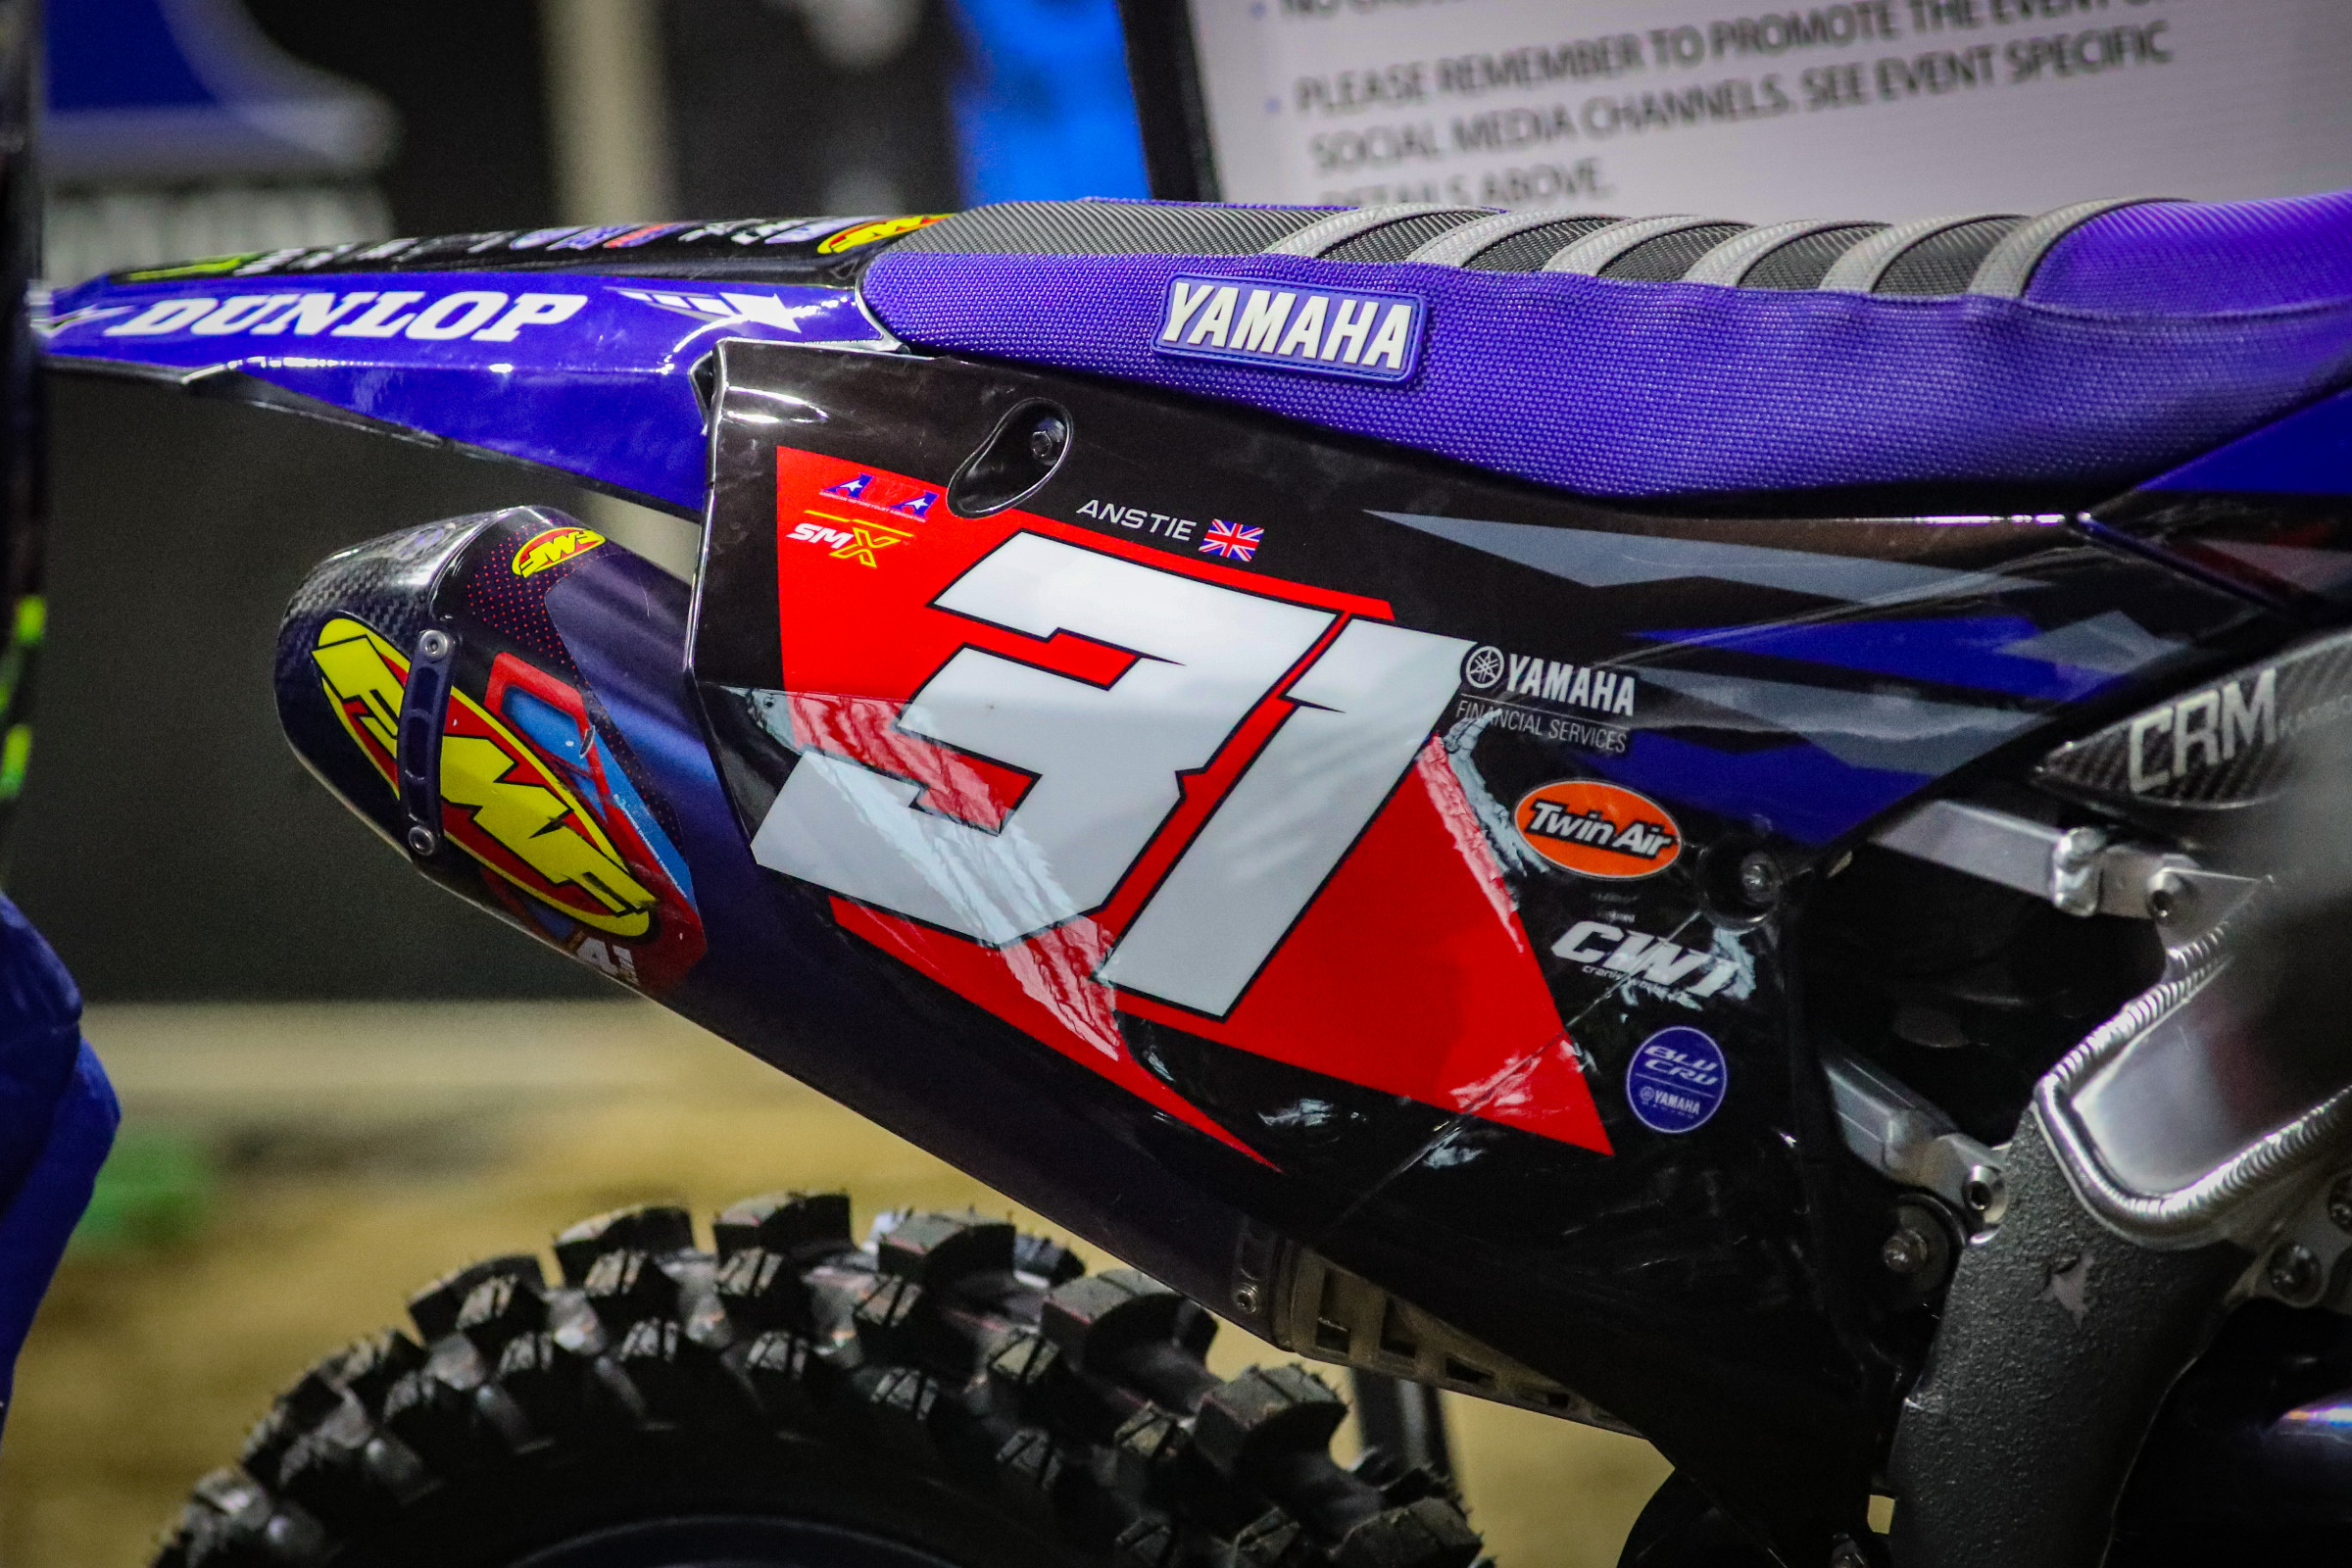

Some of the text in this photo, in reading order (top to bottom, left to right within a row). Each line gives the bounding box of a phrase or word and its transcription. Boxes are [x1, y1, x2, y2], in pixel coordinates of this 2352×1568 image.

[1295, 63, 1428, 113] PLEASE
[1436, 33, 1643, 93] REMEMBER
[1648, 24, 1705, 67] TO
[1709, 2, 1899, 59] PROMOTE
[1907, 0, 1984, 32] THE
[1309, 20, 2173, 174] SOCIAL MEDIA CHANNELS. SEE EVENT SPECIFIC
[1480, 157, 1615, 202] ABOVE.
[103, 291, 588, 343] DUNLOP
[1162, 281, 1413, 370] YAMAHA
[786, 522, 902, 568] SMX
[1076, 499, 1198, 542] ANSTIE
[518, 530, 606, 578] FMF
[1506, 653, 1636, 717] YAMAHA
[1455, 699, 1629, 754] FINANCIAL SERVICES
[750, 529, 1478, 1020] 31
[1530, 801, 1672, 857] Twin Air
[1644, 1045, 1718, 1072] BLU
[1644, 1058, 1718, 1086] CRU
[1654, 1089, 1700, 1115] YAMAHA
